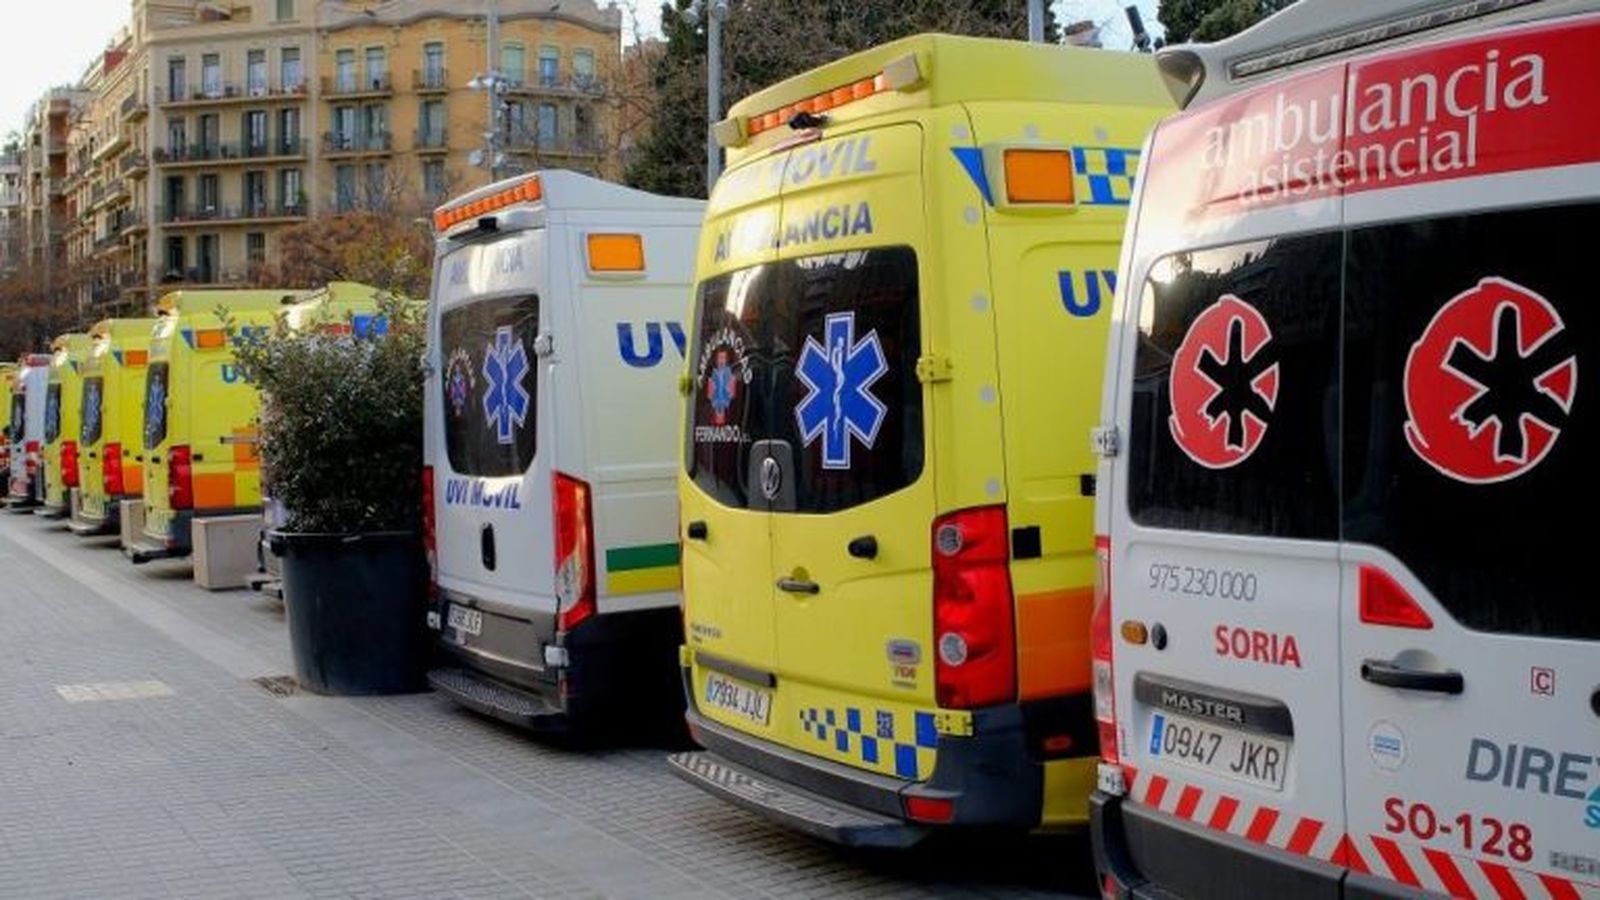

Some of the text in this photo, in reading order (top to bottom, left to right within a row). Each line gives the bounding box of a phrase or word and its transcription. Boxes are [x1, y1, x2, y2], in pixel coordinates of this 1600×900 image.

[1202, 49, 1549, 171] ambulancia
[768, 138, 876, 186] OVIL
[1242, 113, 1478, 206] asistencial
[695, 424, 740, 443] FERNANDO
[446, 479, 469, 505] UVI
[1150, 563, 1258, 602] 975 230 000
[1215, 625, 1302, 669] SORIA
[1536, 672, 1551, 691] C
[1161, 691, 1245, 724] MASTER
[1164, 723, 1281, 783] 0947 JKR
[1466, 738, 1600, 800] DIRE
[1384, 797, 1534, 863] SO-128
